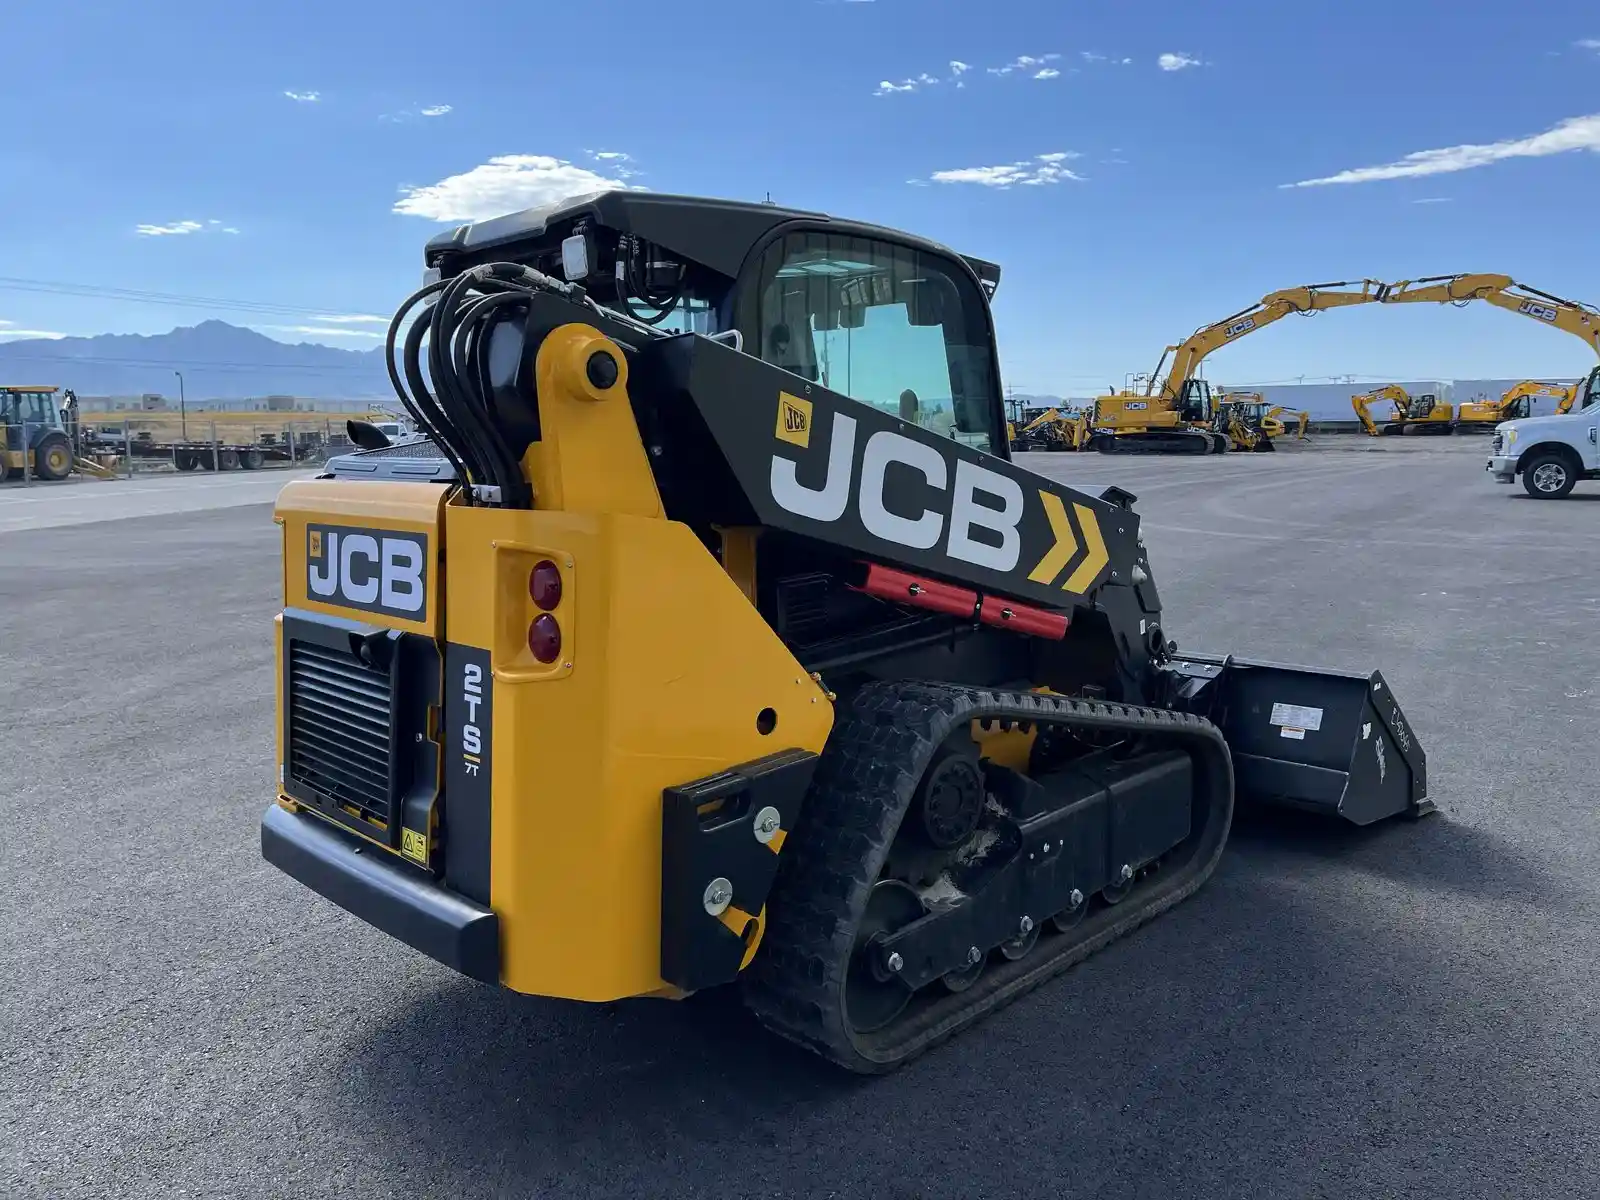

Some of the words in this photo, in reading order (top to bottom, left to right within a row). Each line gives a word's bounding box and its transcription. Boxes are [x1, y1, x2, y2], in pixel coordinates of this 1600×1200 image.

[1519, 303, 1556, 320] JCB
[1226, 320, 1254, 336] JCB
[787, 406, 805, 429] JCB
[1095, 427, 1114, 435] JCB
[771, 411, 1024, 572] JCB
[309, 532, 423, 612] JCB
[463, 663, 482, 754] 2TS
[464, 762, 479, 776] 7T
